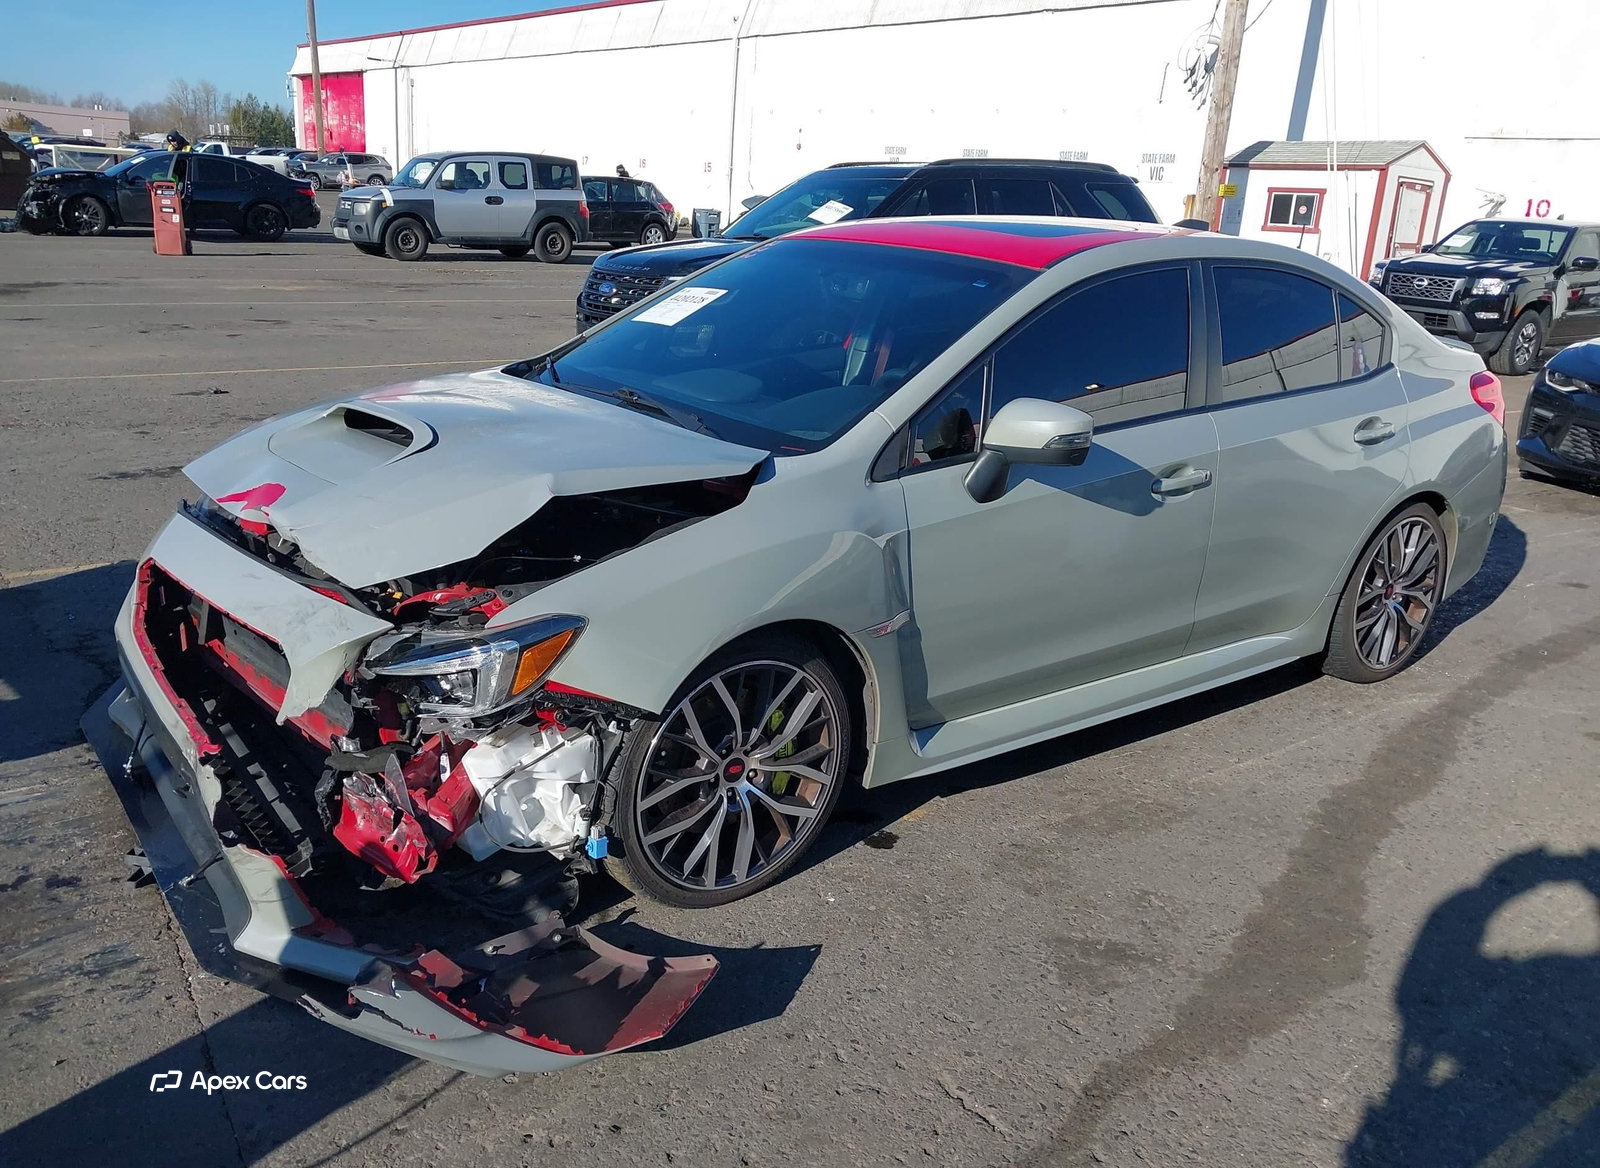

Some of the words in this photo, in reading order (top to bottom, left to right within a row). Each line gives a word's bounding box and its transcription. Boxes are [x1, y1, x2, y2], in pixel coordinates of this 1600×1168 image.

[963, 149, 975, 157] STATE
[975, 149, 989, 157] FARM
[1060, 151, 1073, 160] STATE
[1073, 151, 1089, 160] FARM
[1142, 153, 1158, 163] STATE
[1159, 153, 1176, 163] FARM
[582, 156, 589, 165] 17
[704, 162, 712, 173] 15
[1149, 166, 1165, 181] VIC
[1525, 199, 1551, 218] 10
